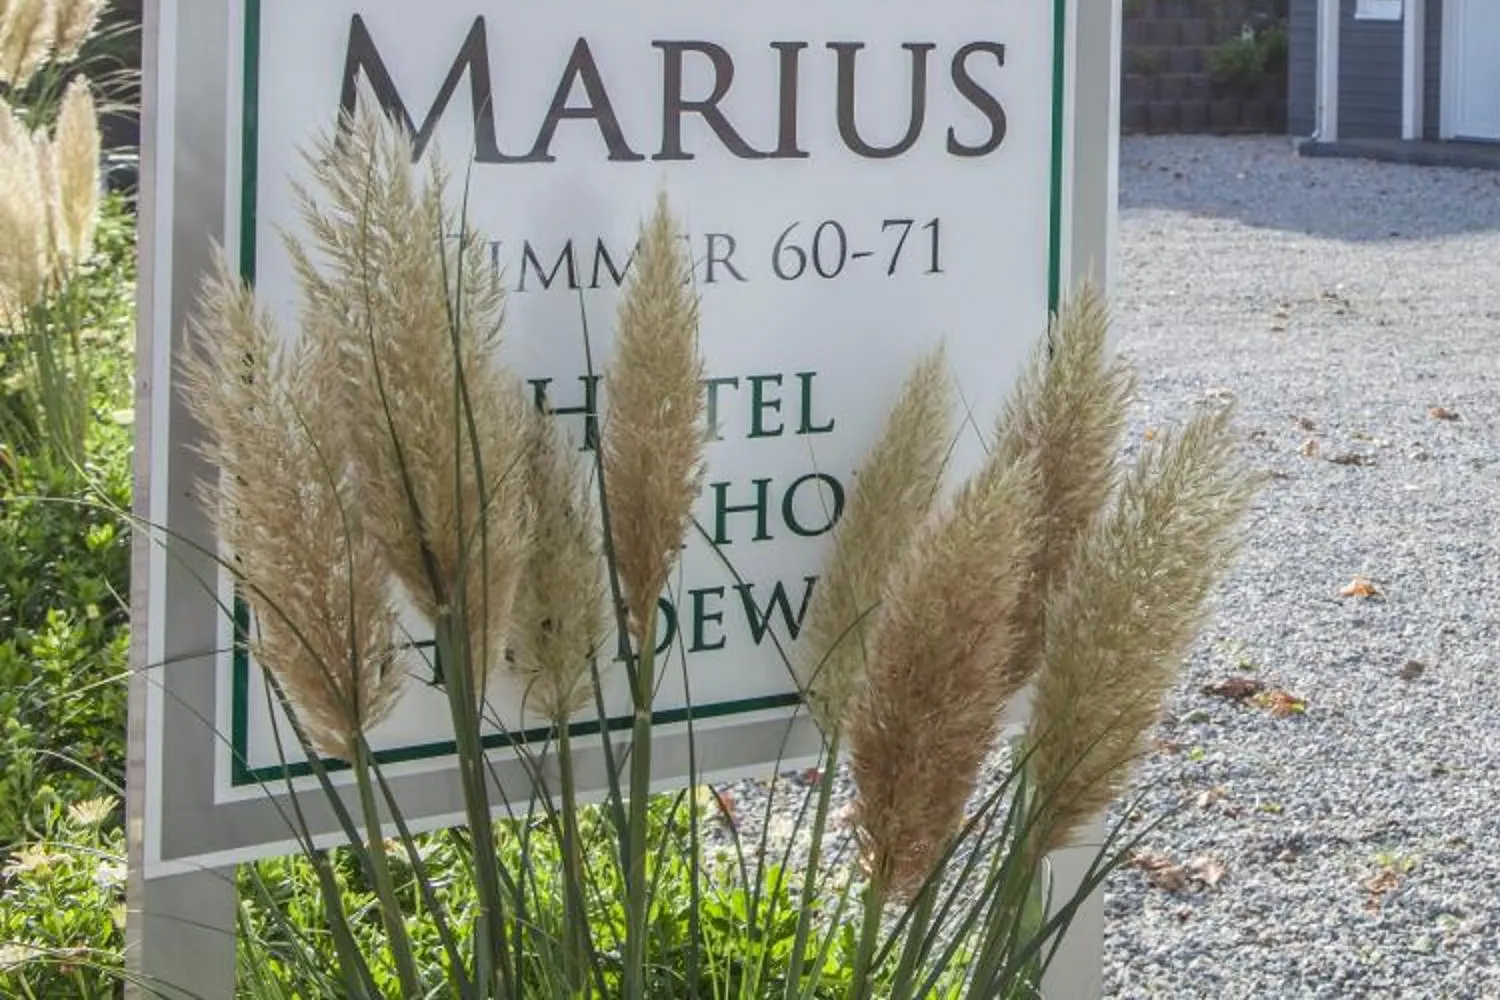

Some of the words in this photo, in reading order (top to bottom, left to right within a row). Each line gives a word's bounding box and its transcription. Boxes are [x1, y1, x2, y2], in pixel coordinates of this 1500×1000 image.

[335, 12, 1009, 164] MARIUS
[438, 231, 750, 293] IMMR
[771, 217, 946, 282] 60-71
[527, 371, 836, 452] HTEL
